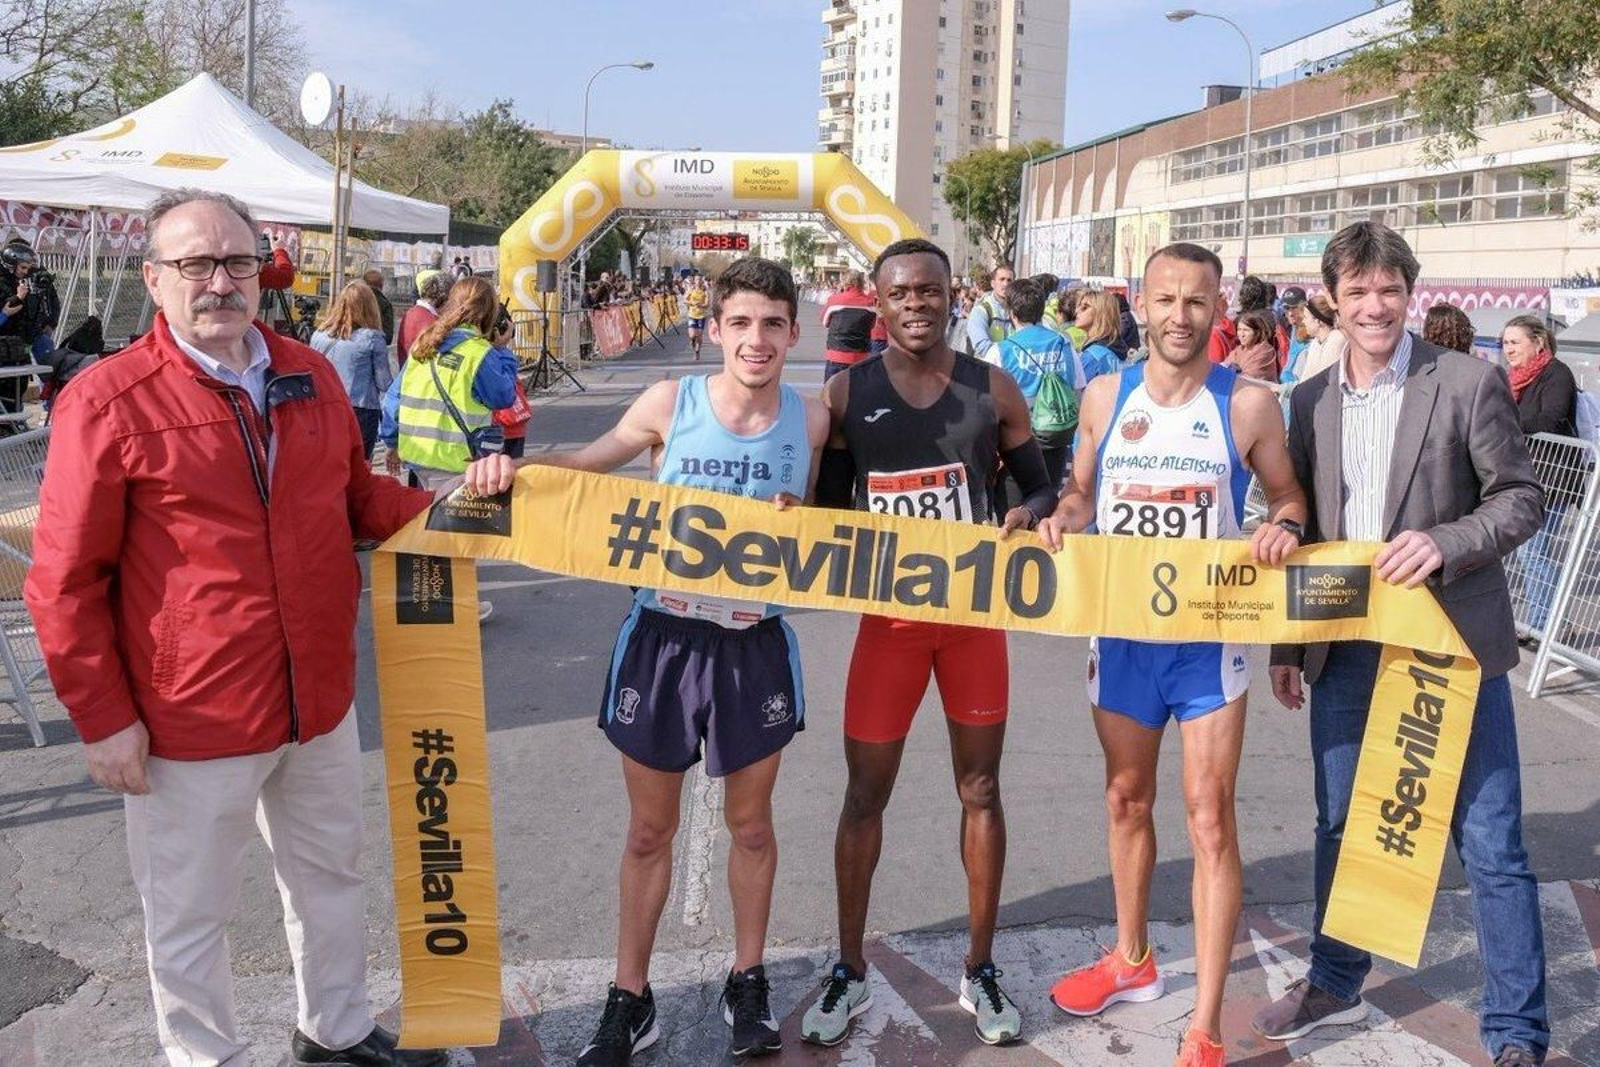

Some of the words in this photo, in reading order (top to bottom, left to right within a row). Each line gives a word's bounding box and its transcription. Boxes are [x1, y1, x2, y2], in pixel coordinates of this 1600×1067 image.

[101, 150, 143, 158] IMD
[673, 159, 715, 174] IMD
[693, 236, 747, 249] 00:33:15
[680, 454, 772, 485] nerja
[1160, 455, 1226, 476] ATLETISMO
[444, 508, 456, 516] DE
[458, 508, 493, 519] SEVILLA
[1112, 503, 1208, 539] 2891
[607, 496, 1059, 621] #Sevilla10
[1207, 564, 1257, 586] IMD
[1296, 588, 1358, 597] AYUNTAMIENTO
[1187, 600, 1226, 609] Instituto
[1228, 600, 1274, 611] Municipal
[1304, 597, 1317, 605] DE
[1201, 611, 1215, 620] de
[1217, 611, 1260, 621] Deportes
[411, 728, 468, 956] #Sevilla10
